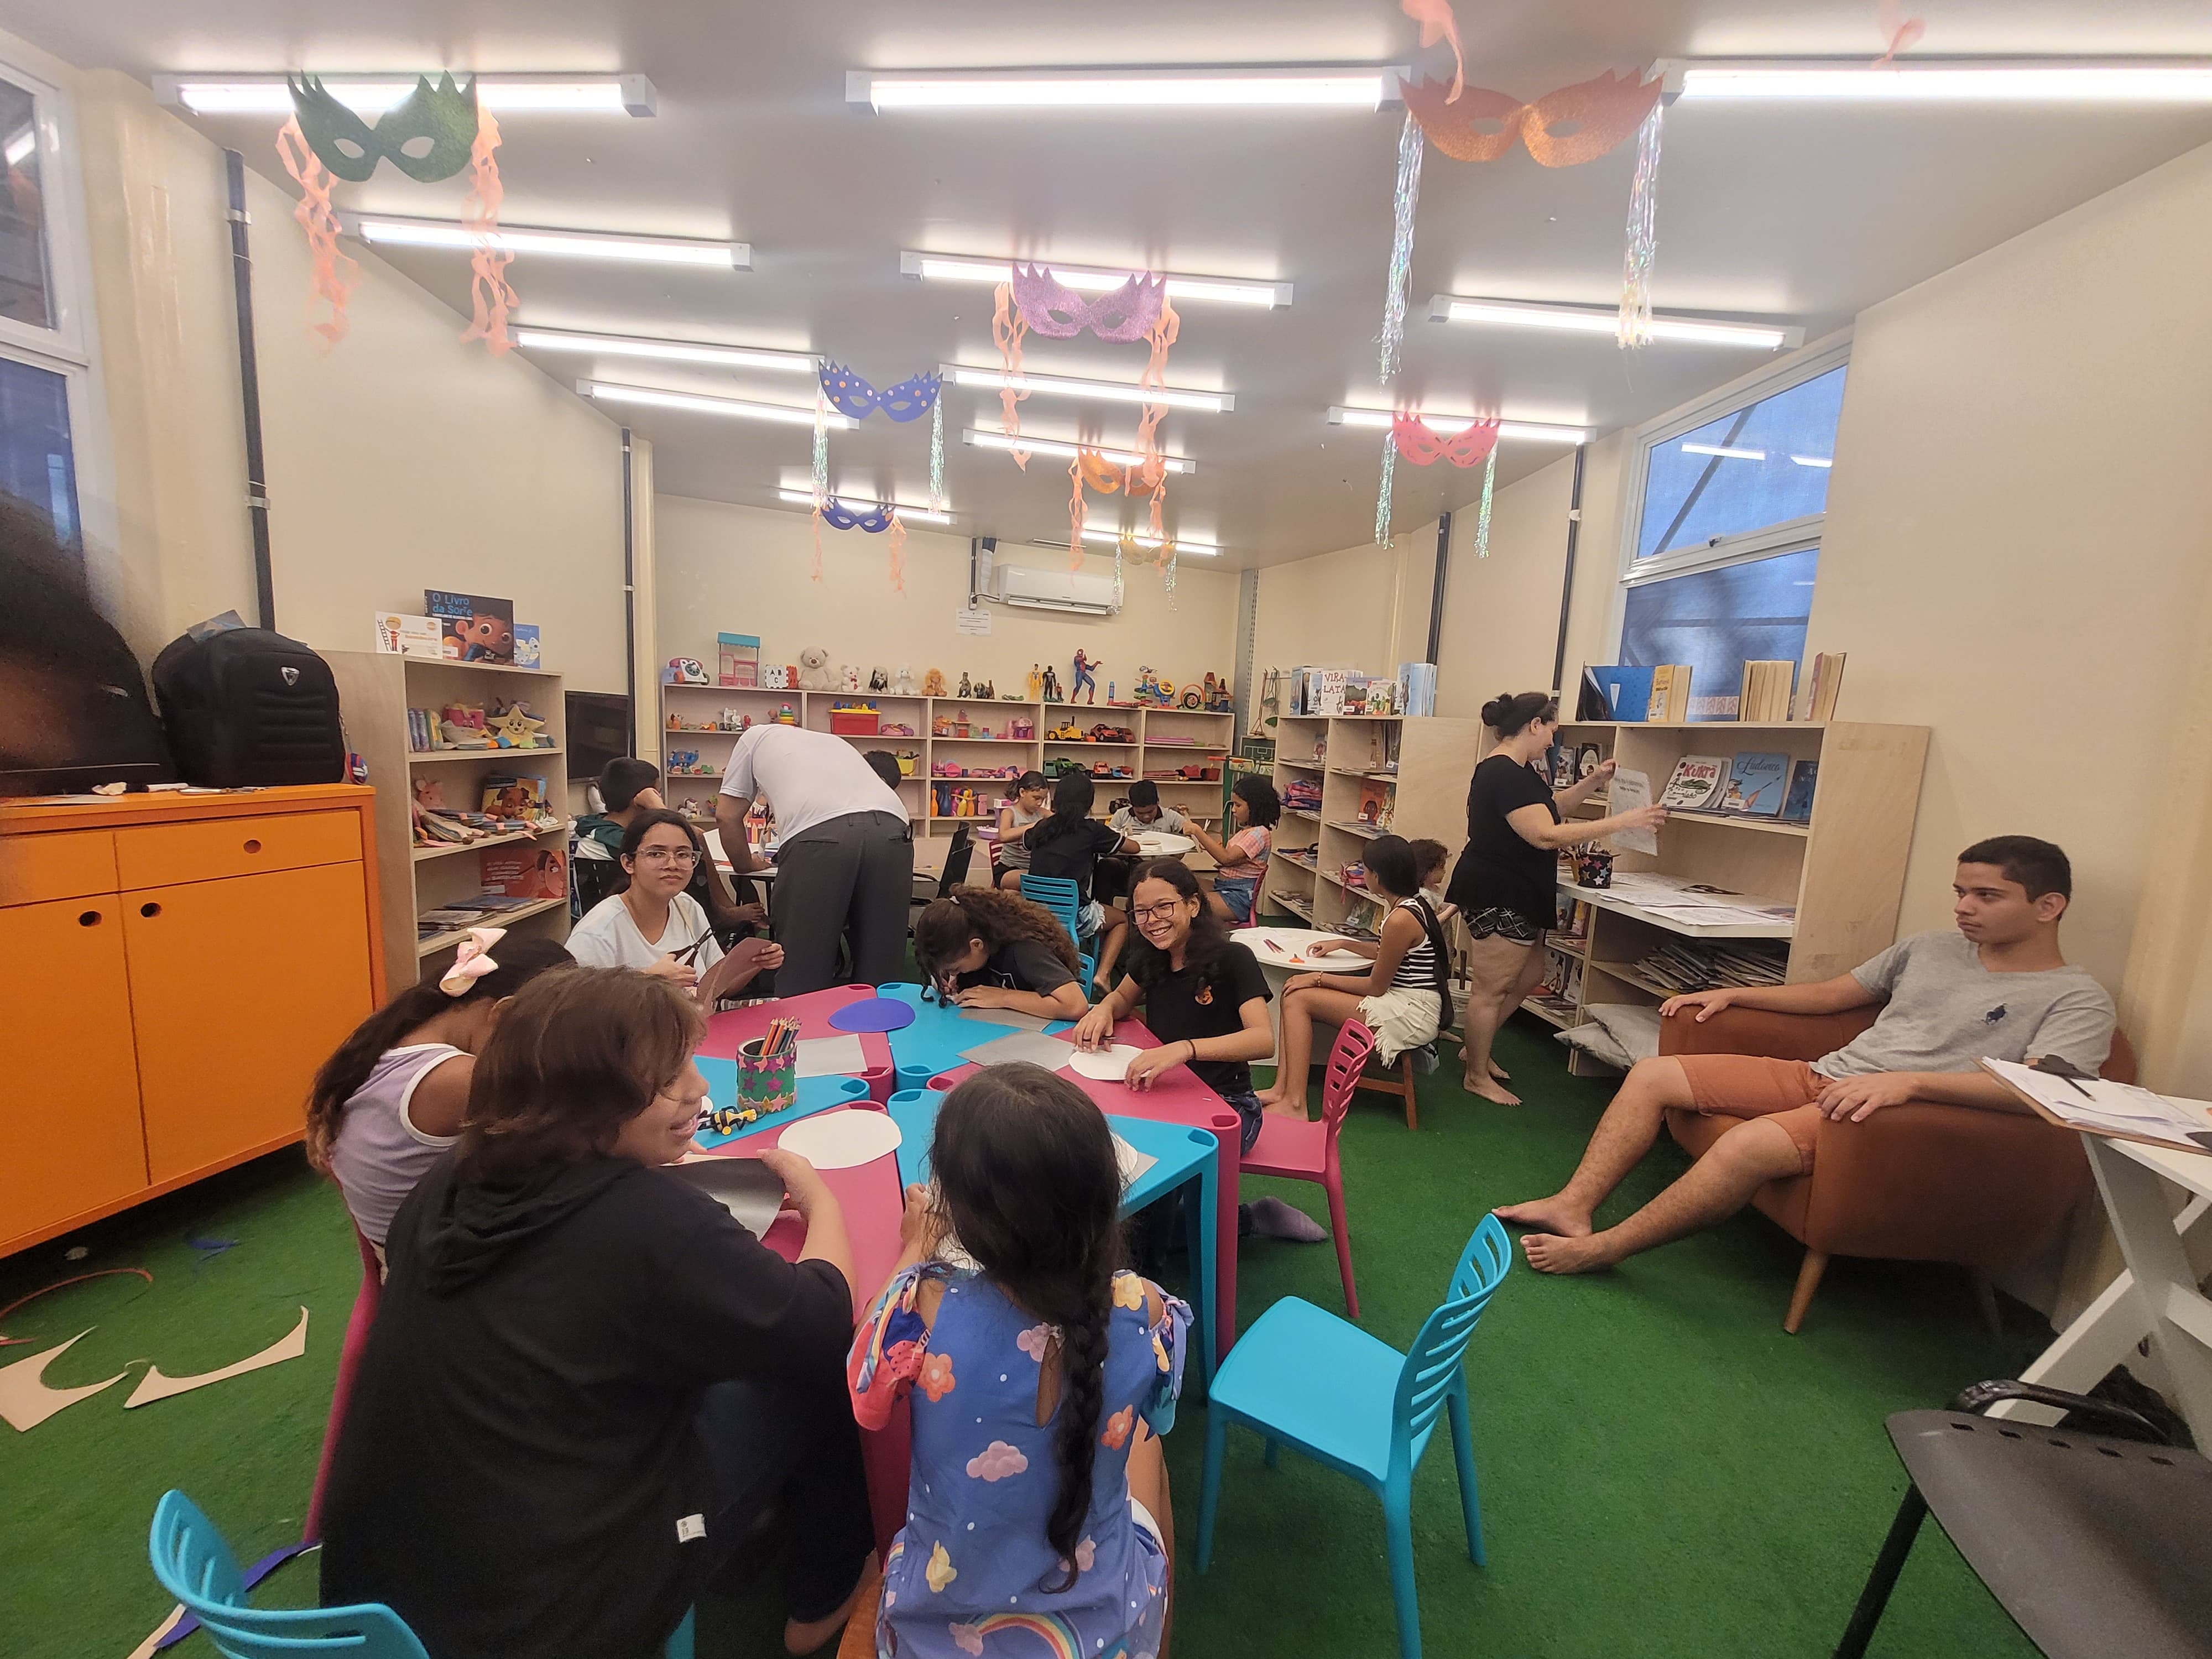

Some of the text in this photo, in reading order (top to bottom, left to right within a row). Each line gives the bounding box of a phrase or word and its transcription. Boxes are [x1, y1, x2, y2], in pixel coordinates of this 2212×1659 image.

[432, 592, 469, 606] O Livro
[432, 603, 445, 613] da
[447, 605, 473, 616] Sorte
[1324, 672, 1344, 682] VIRA
[1323, 685, 1345, 694] LATA
